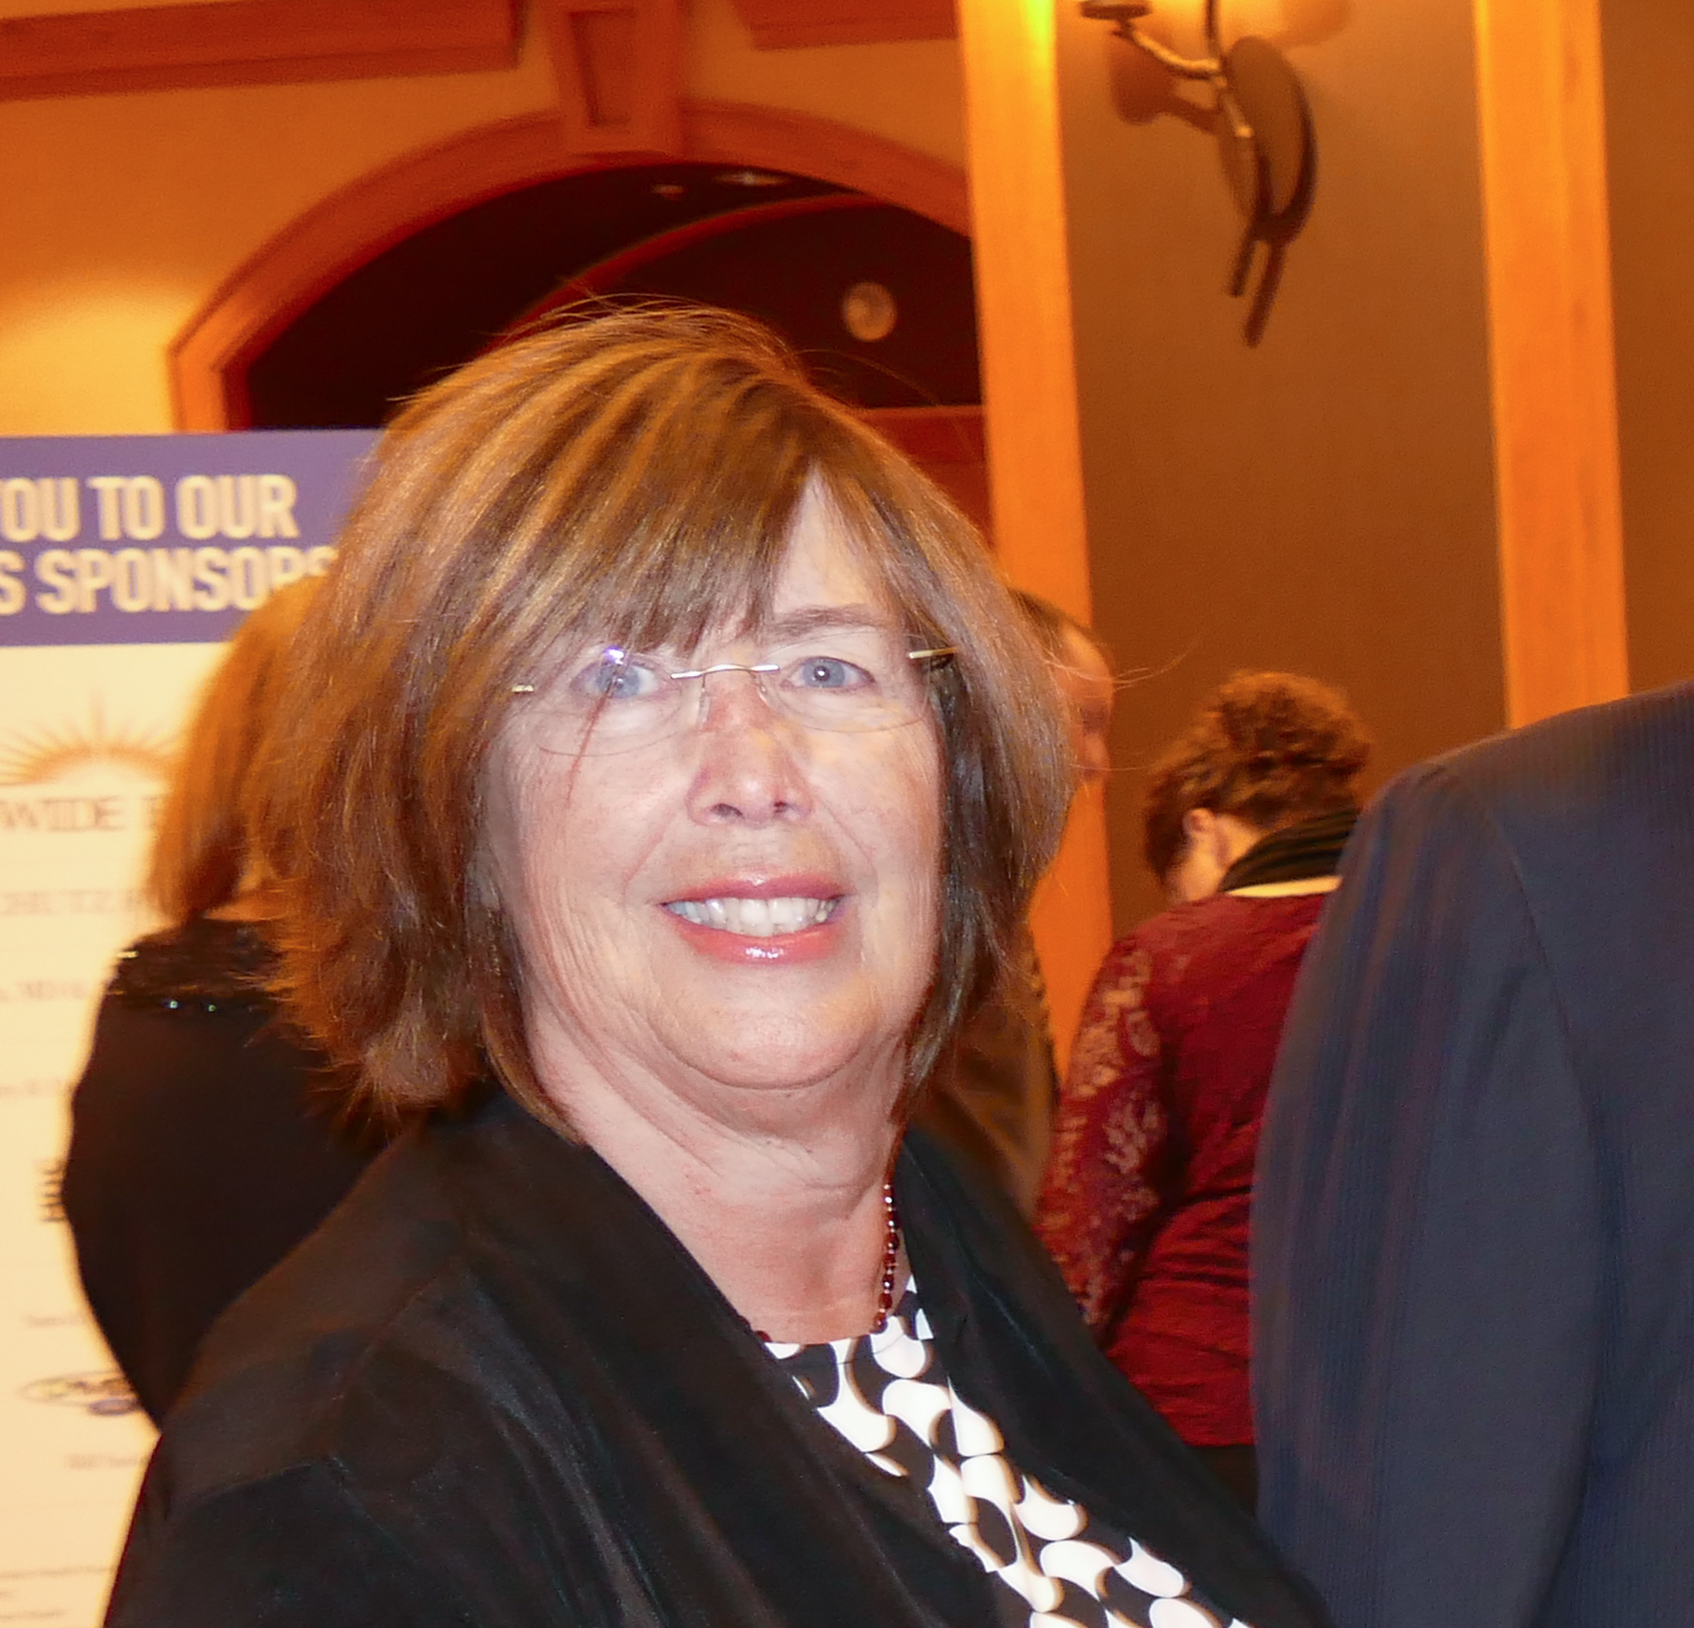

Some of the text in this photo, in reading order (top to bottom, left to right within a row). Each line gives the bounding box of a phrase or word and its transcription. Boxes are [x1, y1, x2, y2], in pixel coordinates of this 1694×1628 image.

[0, 474, 299, 542] OU TO OUR
